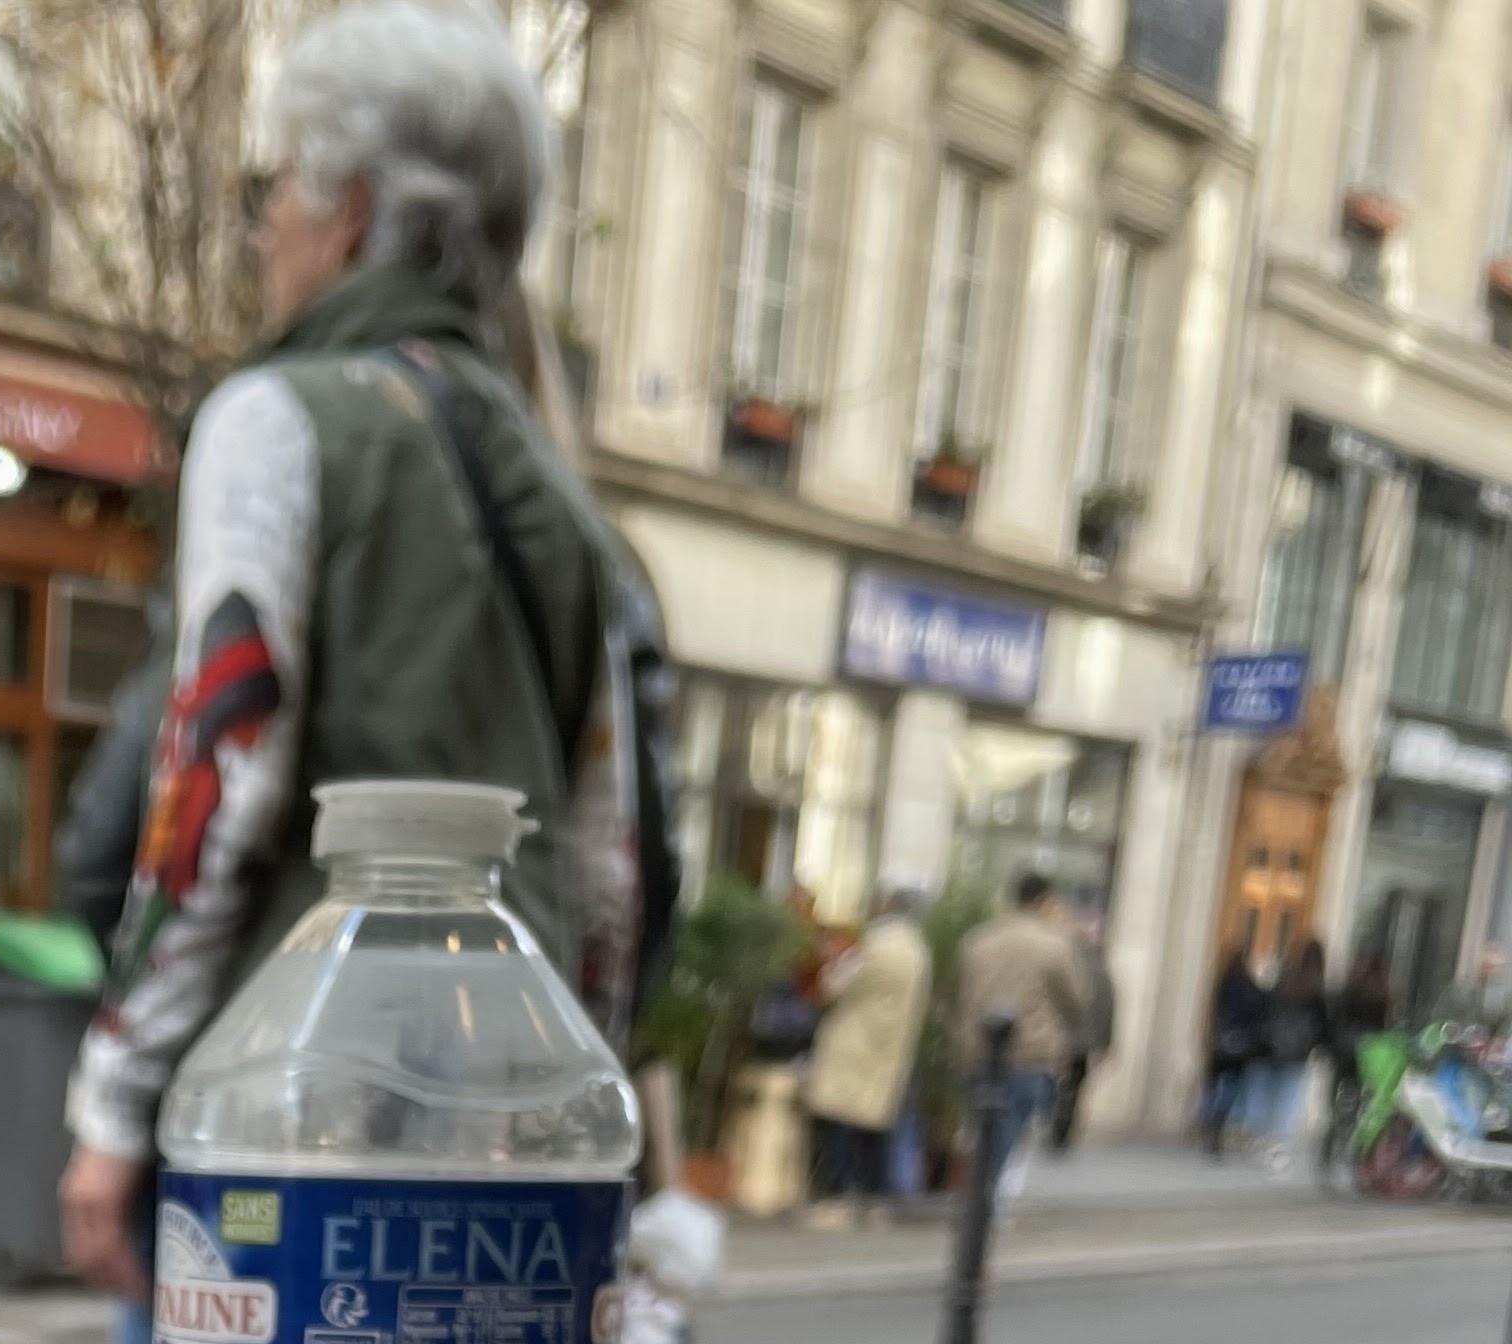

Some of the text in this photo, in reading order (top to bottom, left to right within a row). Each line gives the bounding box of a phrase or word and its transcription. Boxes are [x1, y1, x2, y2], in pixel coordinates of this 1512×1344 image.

[223, 1197, 276, 1222] SANS
[321, 1216, 572, 1283] ELENA
[154, 1284, 268, 1336] ALINE
